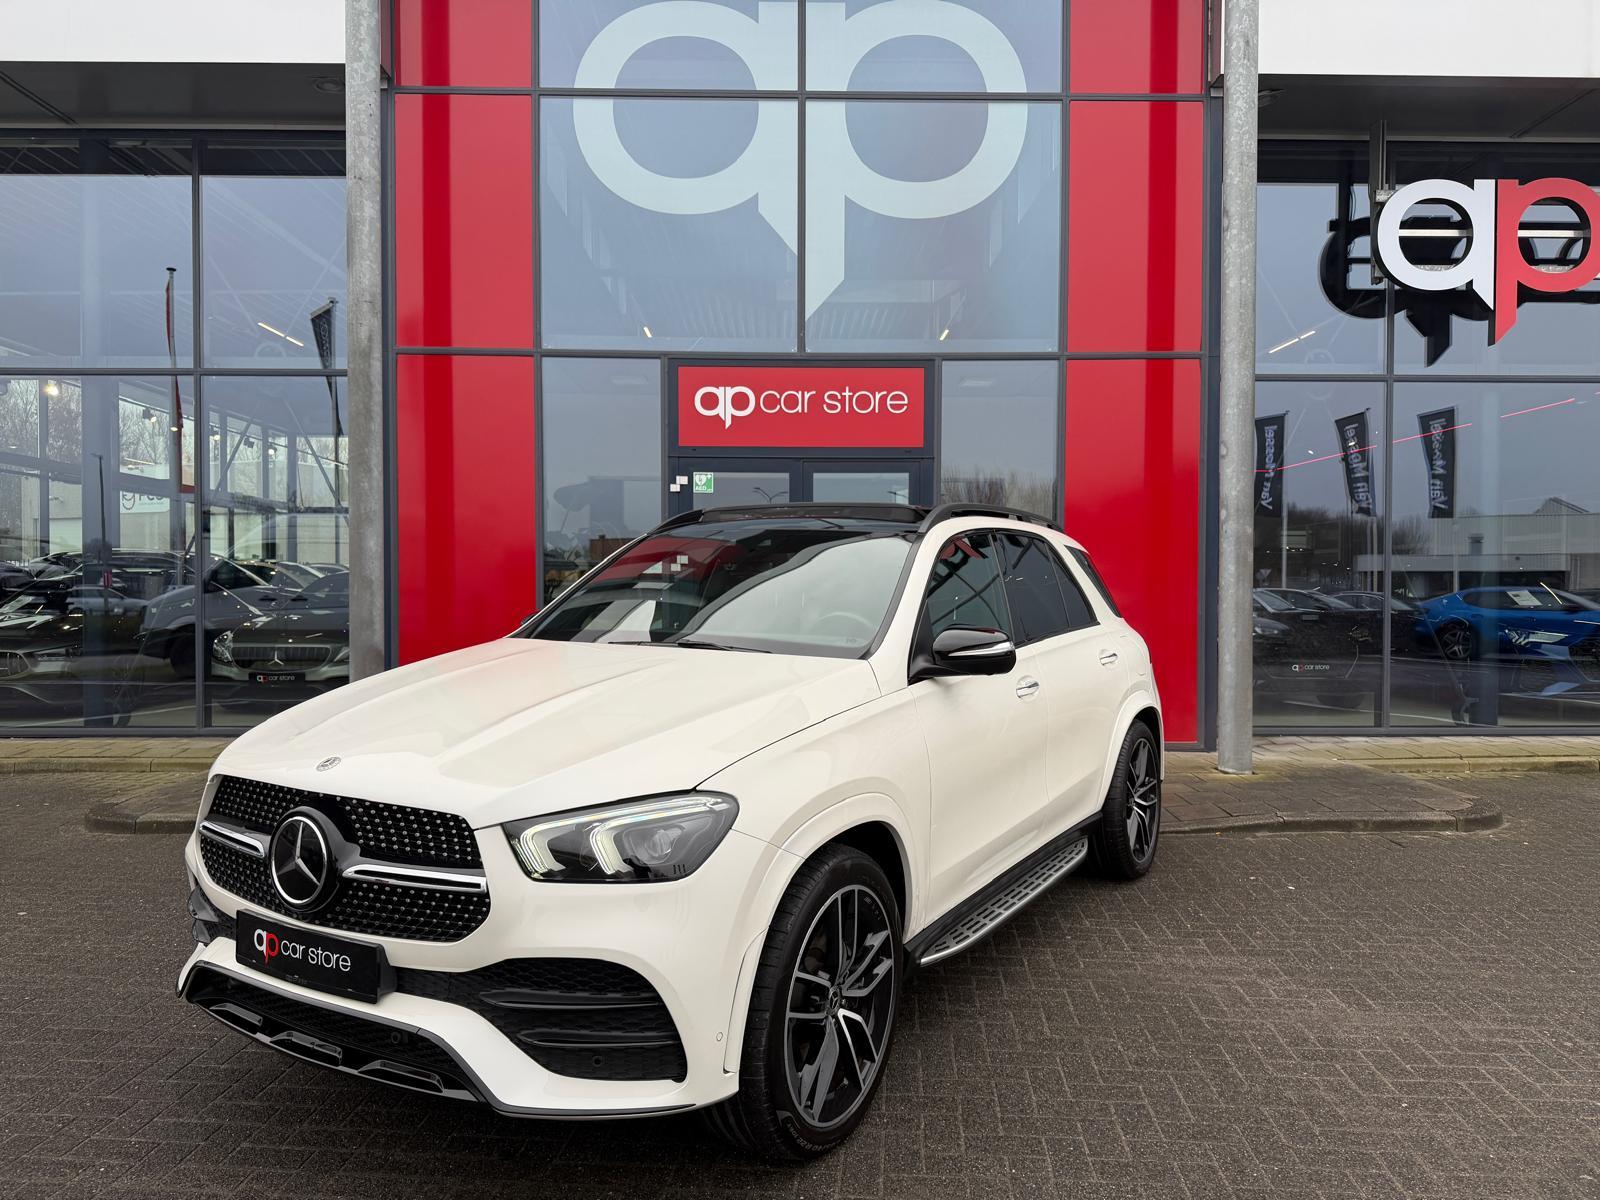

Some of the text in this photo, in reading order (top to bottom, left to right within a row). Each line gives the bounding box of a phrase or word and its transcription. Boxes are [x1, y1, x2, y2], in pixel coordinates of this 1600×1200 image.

[694, 386, 909, 430] ap car store
[280, 940, 306, 960] car
[308, 946, 352, 972] store
